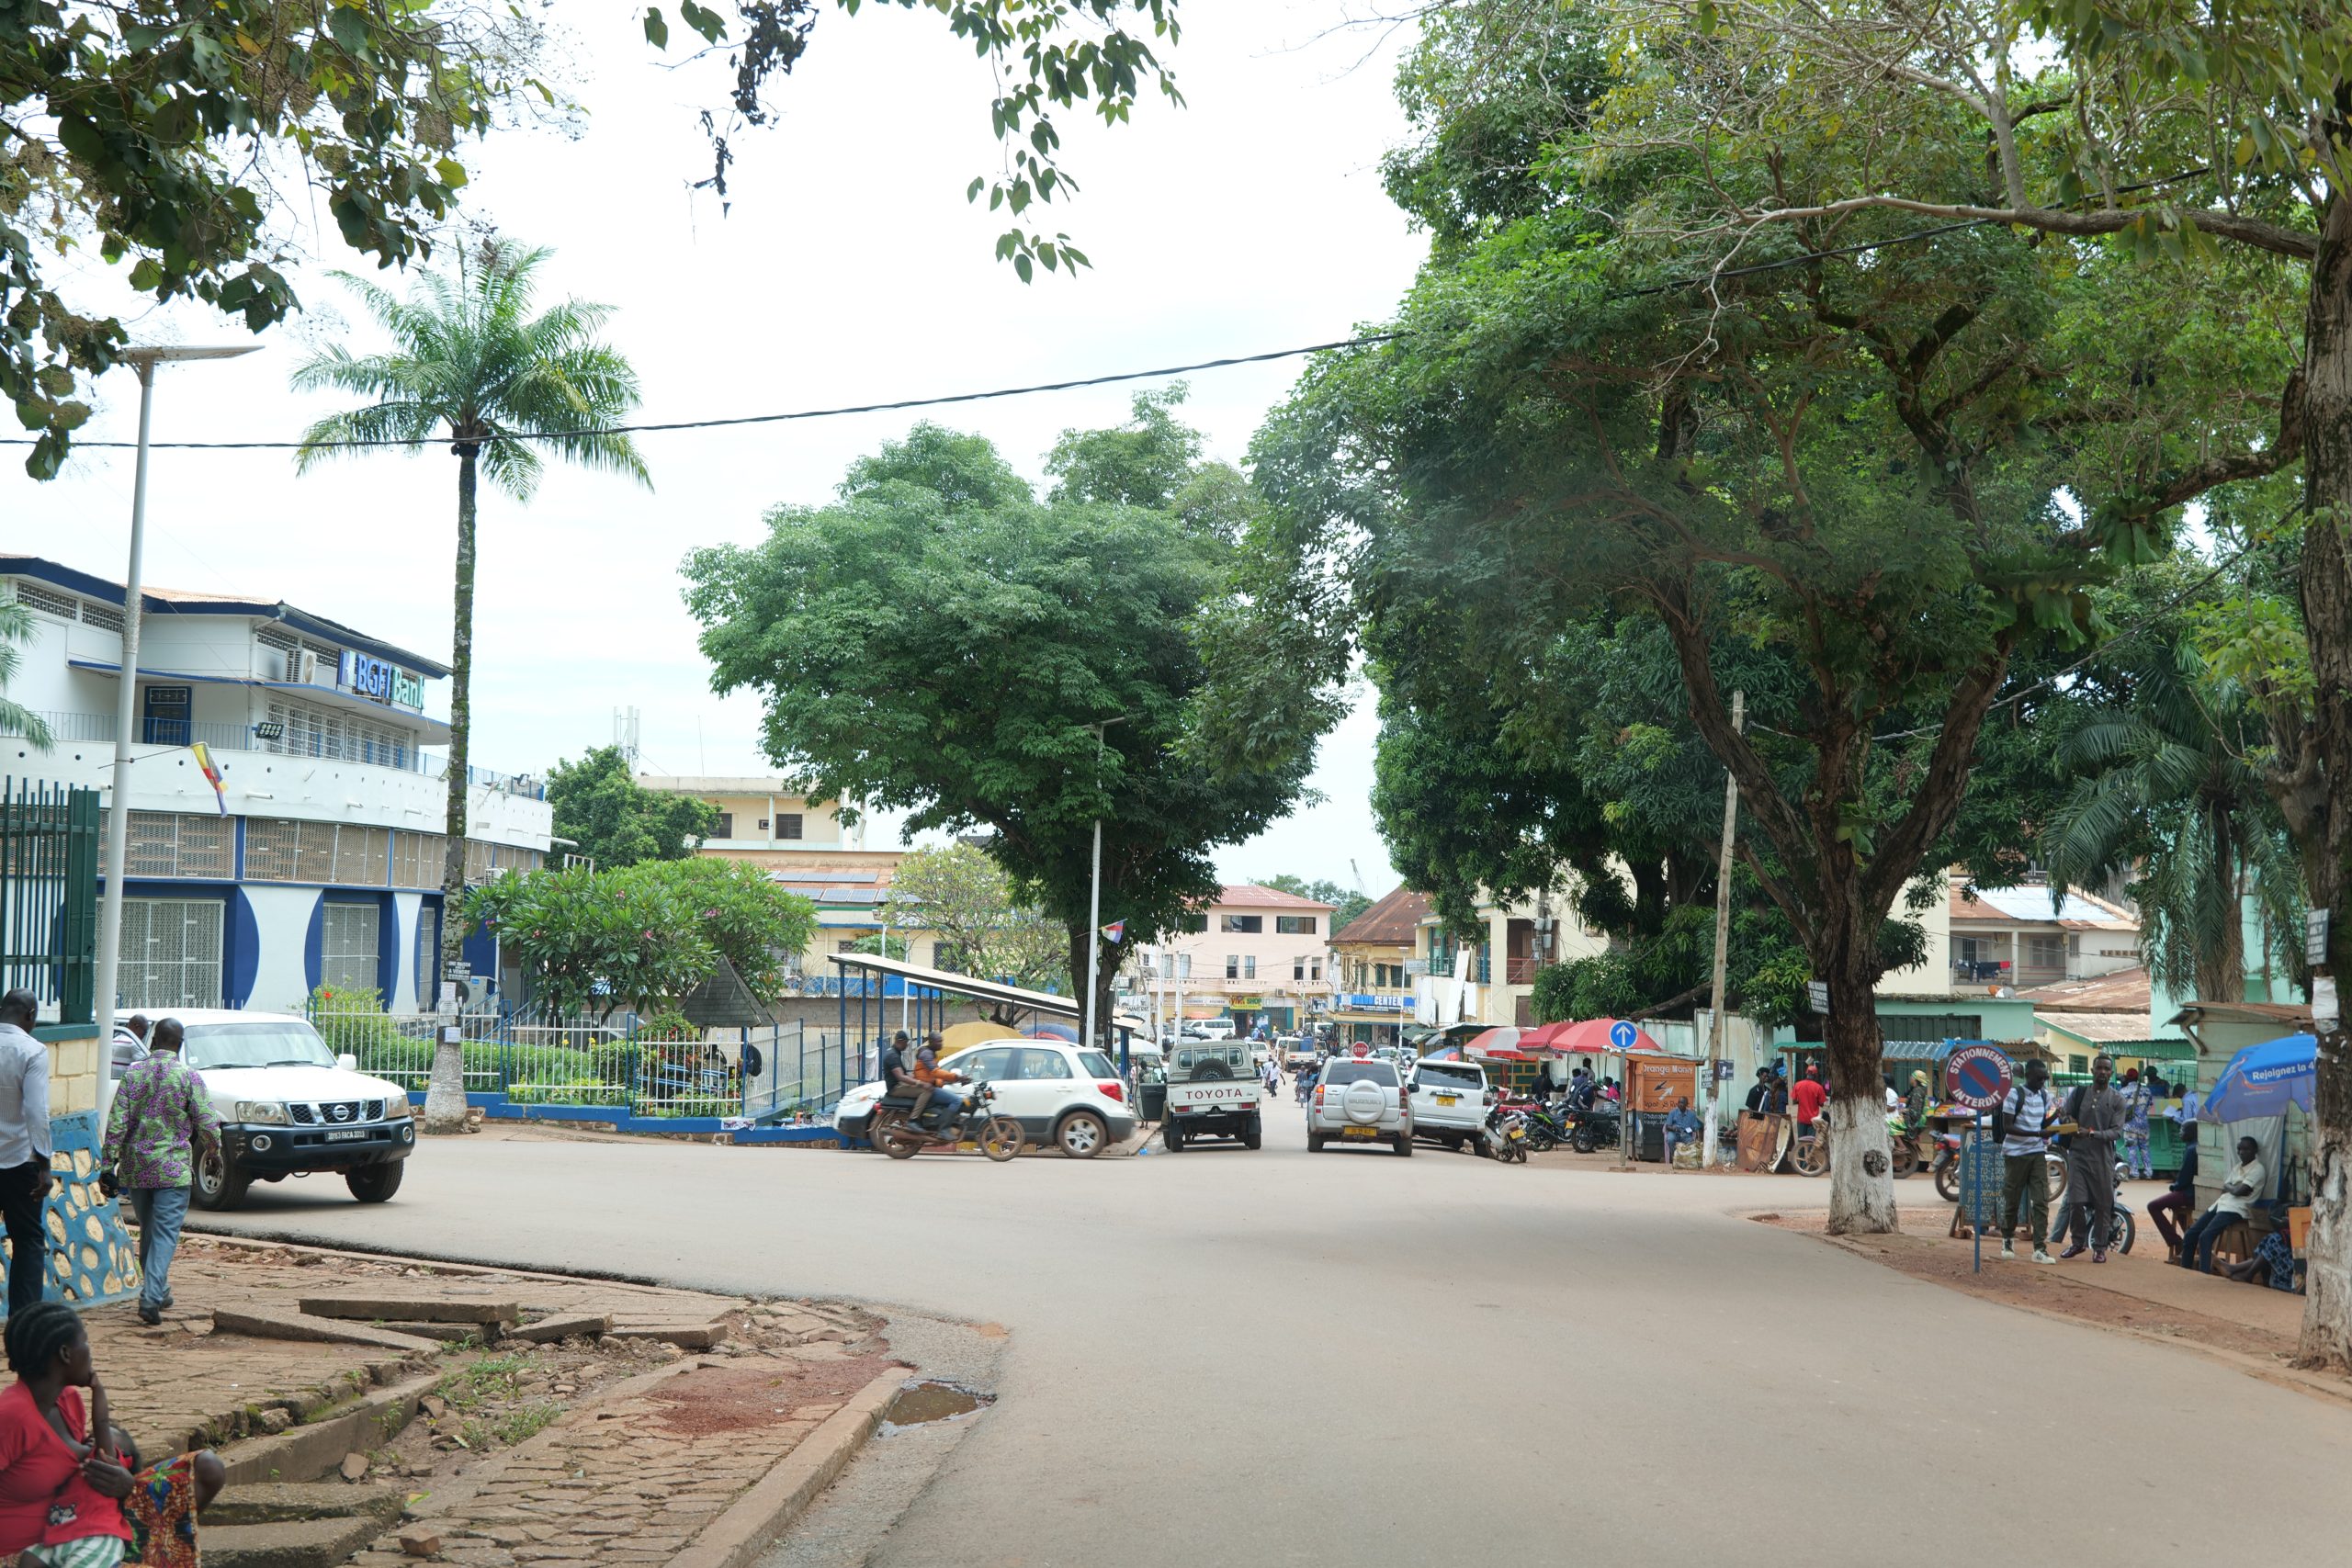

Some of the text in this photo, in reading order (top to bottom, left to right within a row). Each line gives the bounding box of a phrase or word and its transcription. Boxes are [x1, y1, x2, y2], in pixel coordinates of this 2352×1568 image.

[356, 653, 424, 709] BGFI Bank
[1374, 996, 1401, 1007] CENTER
[1950, 1047, 2010, 1080] STATIONNEMENT
[2252, 1066, 2296, 1081] Rejoignez
[2298, 1064, 2306, 1072] la
[1185, 1089, 1242, 1100] TOYOTA
[1952, 1088, 2002, 1108] INTERDIT
